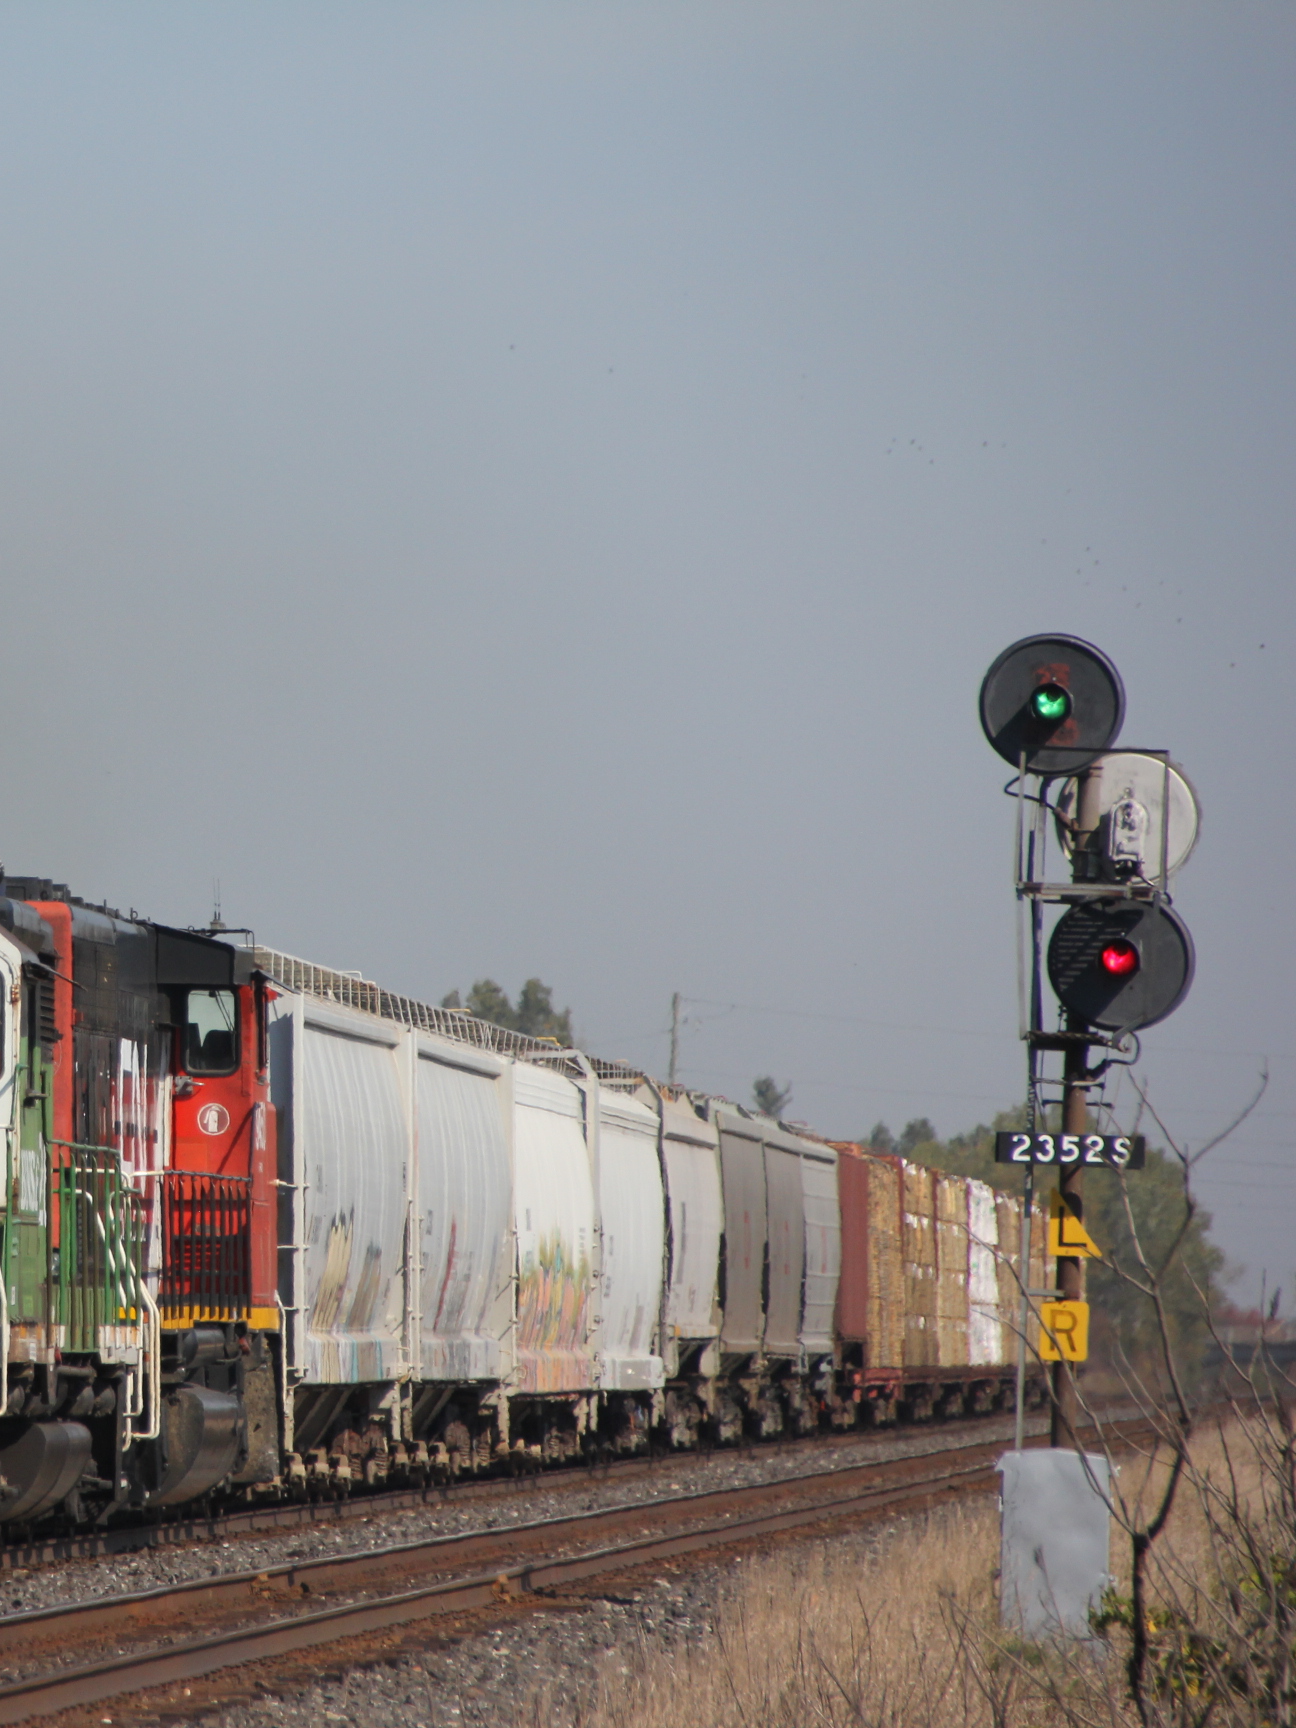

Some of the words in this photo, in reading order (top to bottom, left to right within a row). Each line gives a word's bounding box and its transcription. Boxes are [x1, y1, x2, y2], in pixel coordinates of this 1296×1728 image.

[1010, 1133, 1132, 1165] 2352S
[1058, 1205, 1088, 1248] L
[1049, 1308, 1078, 1353] R
